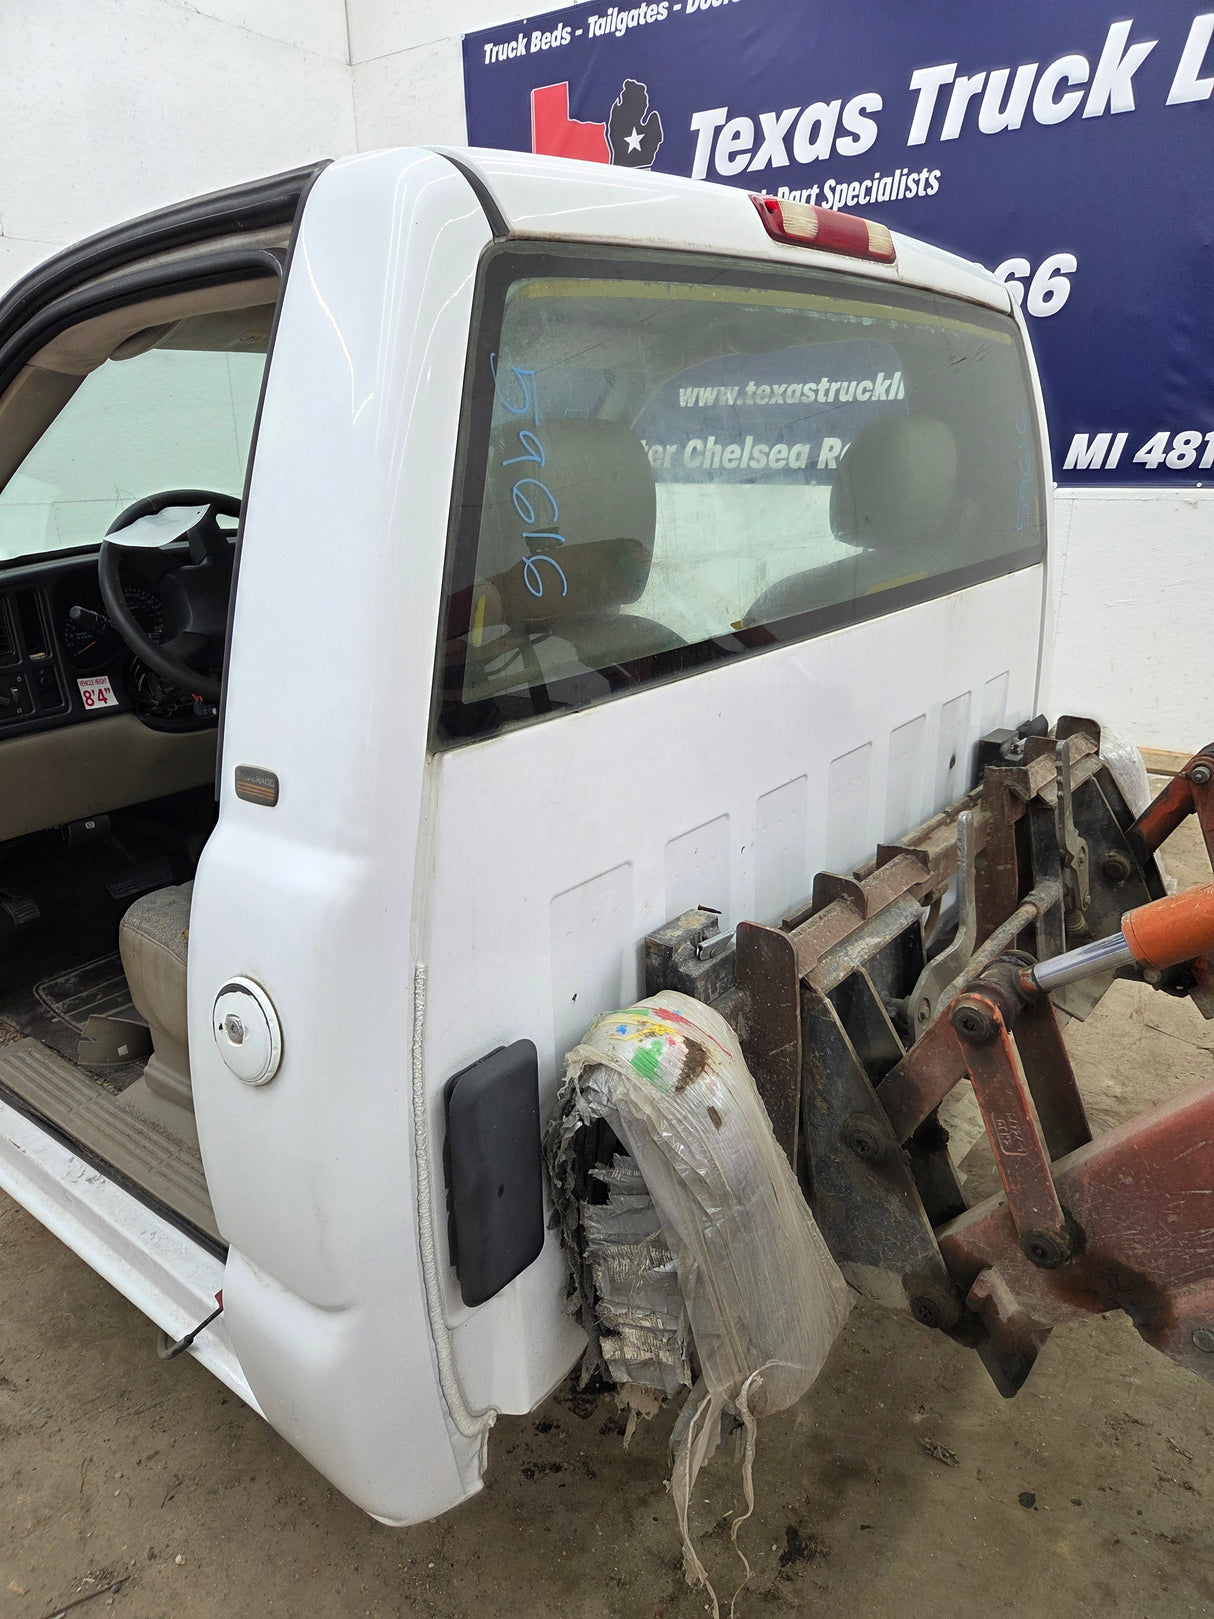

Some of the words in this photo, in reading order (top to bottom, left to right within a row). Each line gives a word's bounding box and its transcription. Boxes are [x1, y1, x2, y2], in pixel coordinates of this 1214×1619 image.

[484, 33, 527, 65] Truck
[530, 23, 571, 53] Beds
[588, 1, 669, 38] Tailgates
[690, 92, 883, 180] Texas
[907, 19, 1159, 146] Truck
[821, 168, 941, 211] Specialists
[683, 436, 811, 470] Chelsea
[817, 437, 851, 469] R
[1063, 432, 1129, 470] MI
